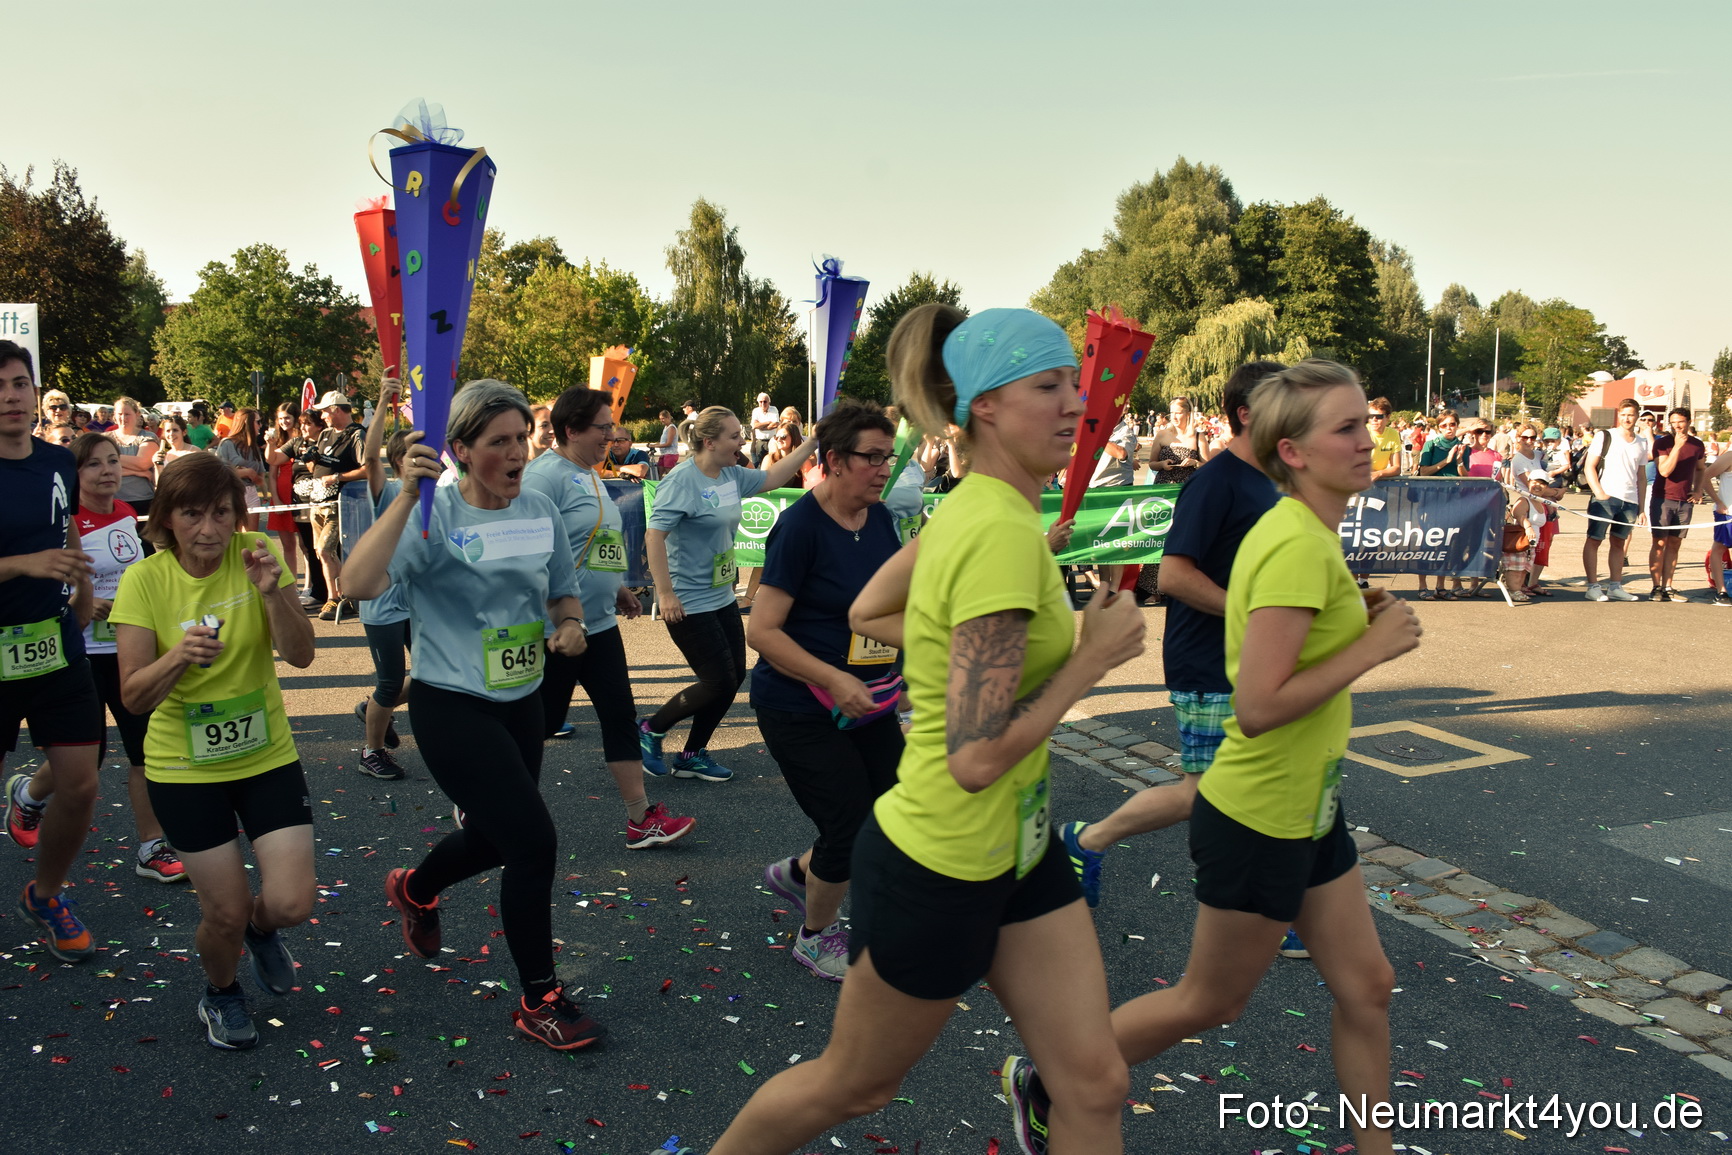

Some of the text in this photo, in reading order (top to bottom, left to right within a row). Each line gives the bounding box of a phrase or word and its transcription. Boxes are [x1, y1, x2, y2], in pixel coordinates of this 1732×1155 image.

[1093, 539, 1110, 549] Die
[1338, 521, 1460, 548] Fischer
[599, 544, 622, 561] 650
[1344, 550, 1448, 562] AUTOMOBILE
[8, 636, 57, 664] 1598
[501, 643, 537, 671] 645
[205, 716, 253, 746] 937
[206, 744, 231, 753] Kratzer
[232, 737, 258, 749] Gerlinde
